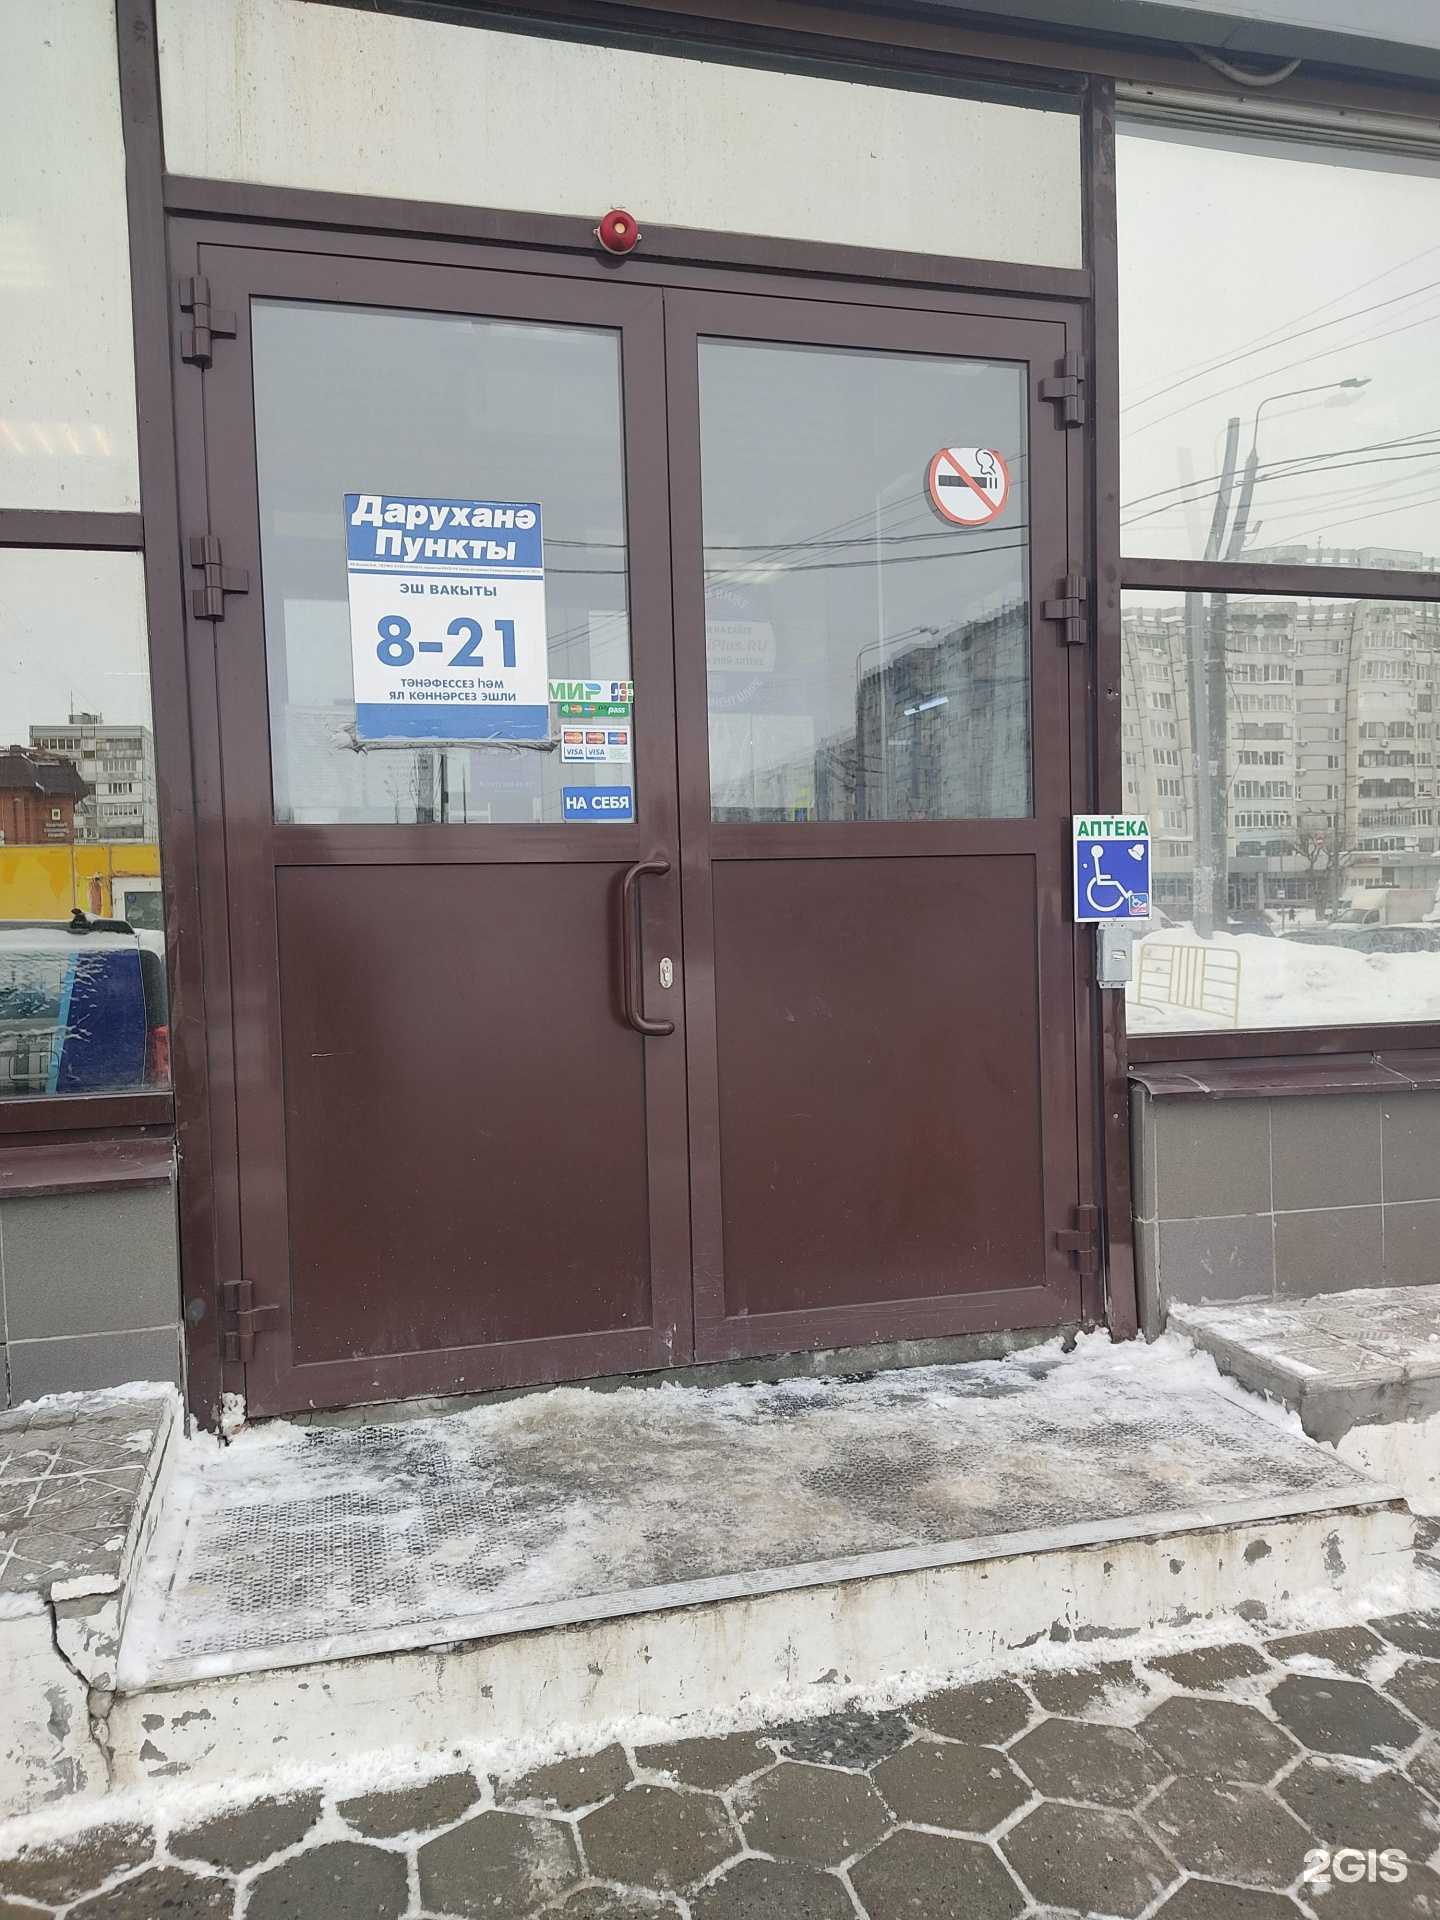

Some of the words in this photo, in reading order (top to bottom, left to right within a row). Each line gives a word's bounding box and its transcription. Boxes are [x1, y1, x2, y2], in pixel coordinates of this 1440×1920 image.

[351, 496, 536, 531] Даруханә
[375, 529, 516, 562] Пункты
[400, 583, 424, 594] ЭШ
[429, 584, 497, 597] ВАКЫТЫ
[377, 614, 517, 668] 8-21
[401, 678, 475, 689] ТӘНӘФЕССЕЗ
[549, 682, 602, 700] МИР
[389, 691, 405, 700] ЯЛ
[409, 691, 477, 701] КӨННӘРСЕЗ
[481, 692, 516, 702] ЭШЛИ
[566, 797, 587, 809] НА
[591, 796, 629, 809] СЕБЯ
[1077, 820, 1149, 837] АПТЕКА
